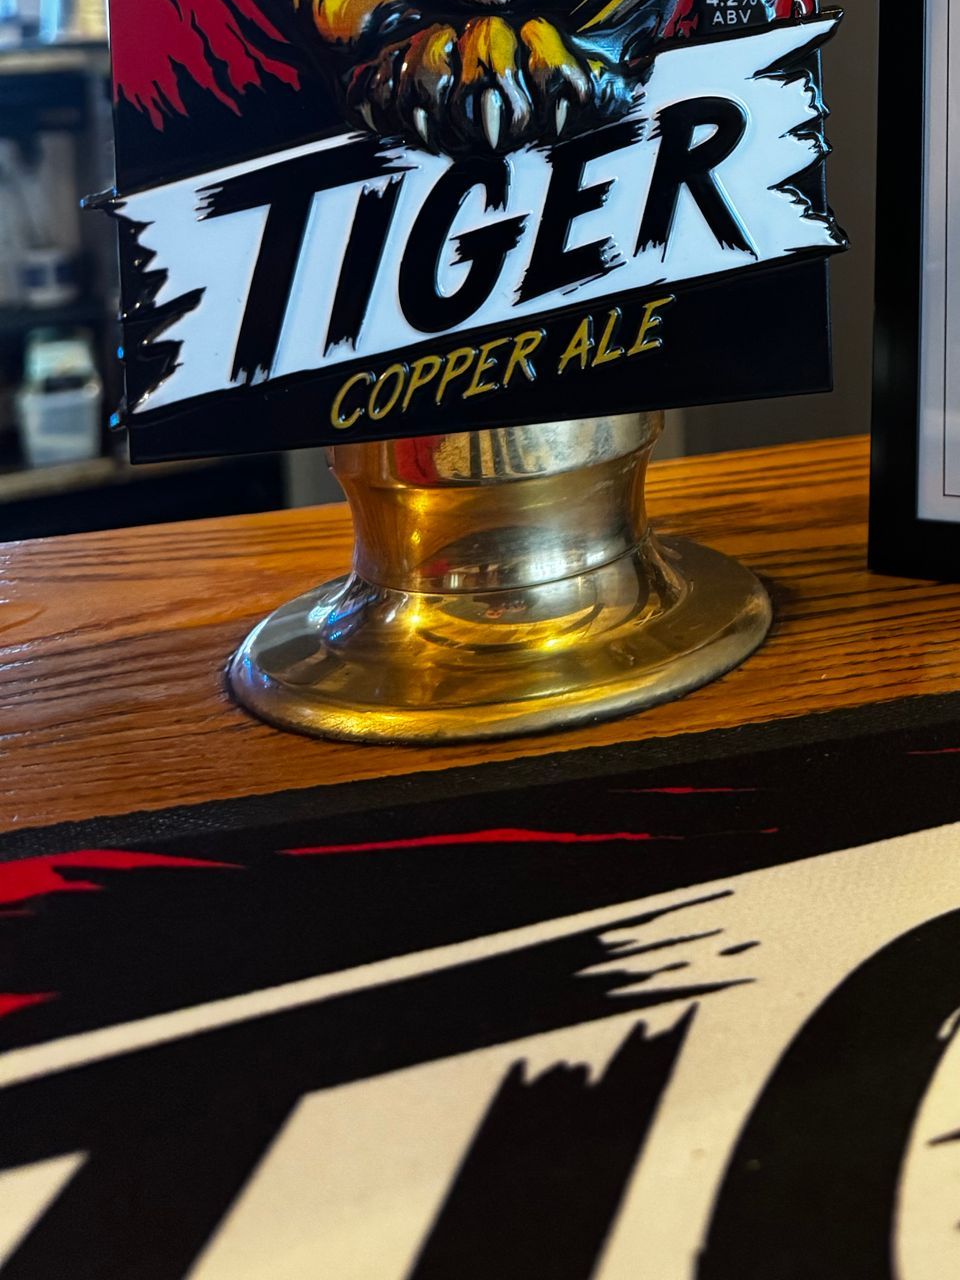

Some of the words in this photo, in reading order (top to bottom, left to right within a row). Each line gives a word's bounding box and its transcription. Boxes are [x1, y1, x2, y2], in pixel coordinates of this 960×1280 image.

[712, 9, 751, 25] ABV
[194, 95, 759, 384] TIGER
[329, 326, 549, 431] COPPER
[557, 296, 677, 376] ALE
